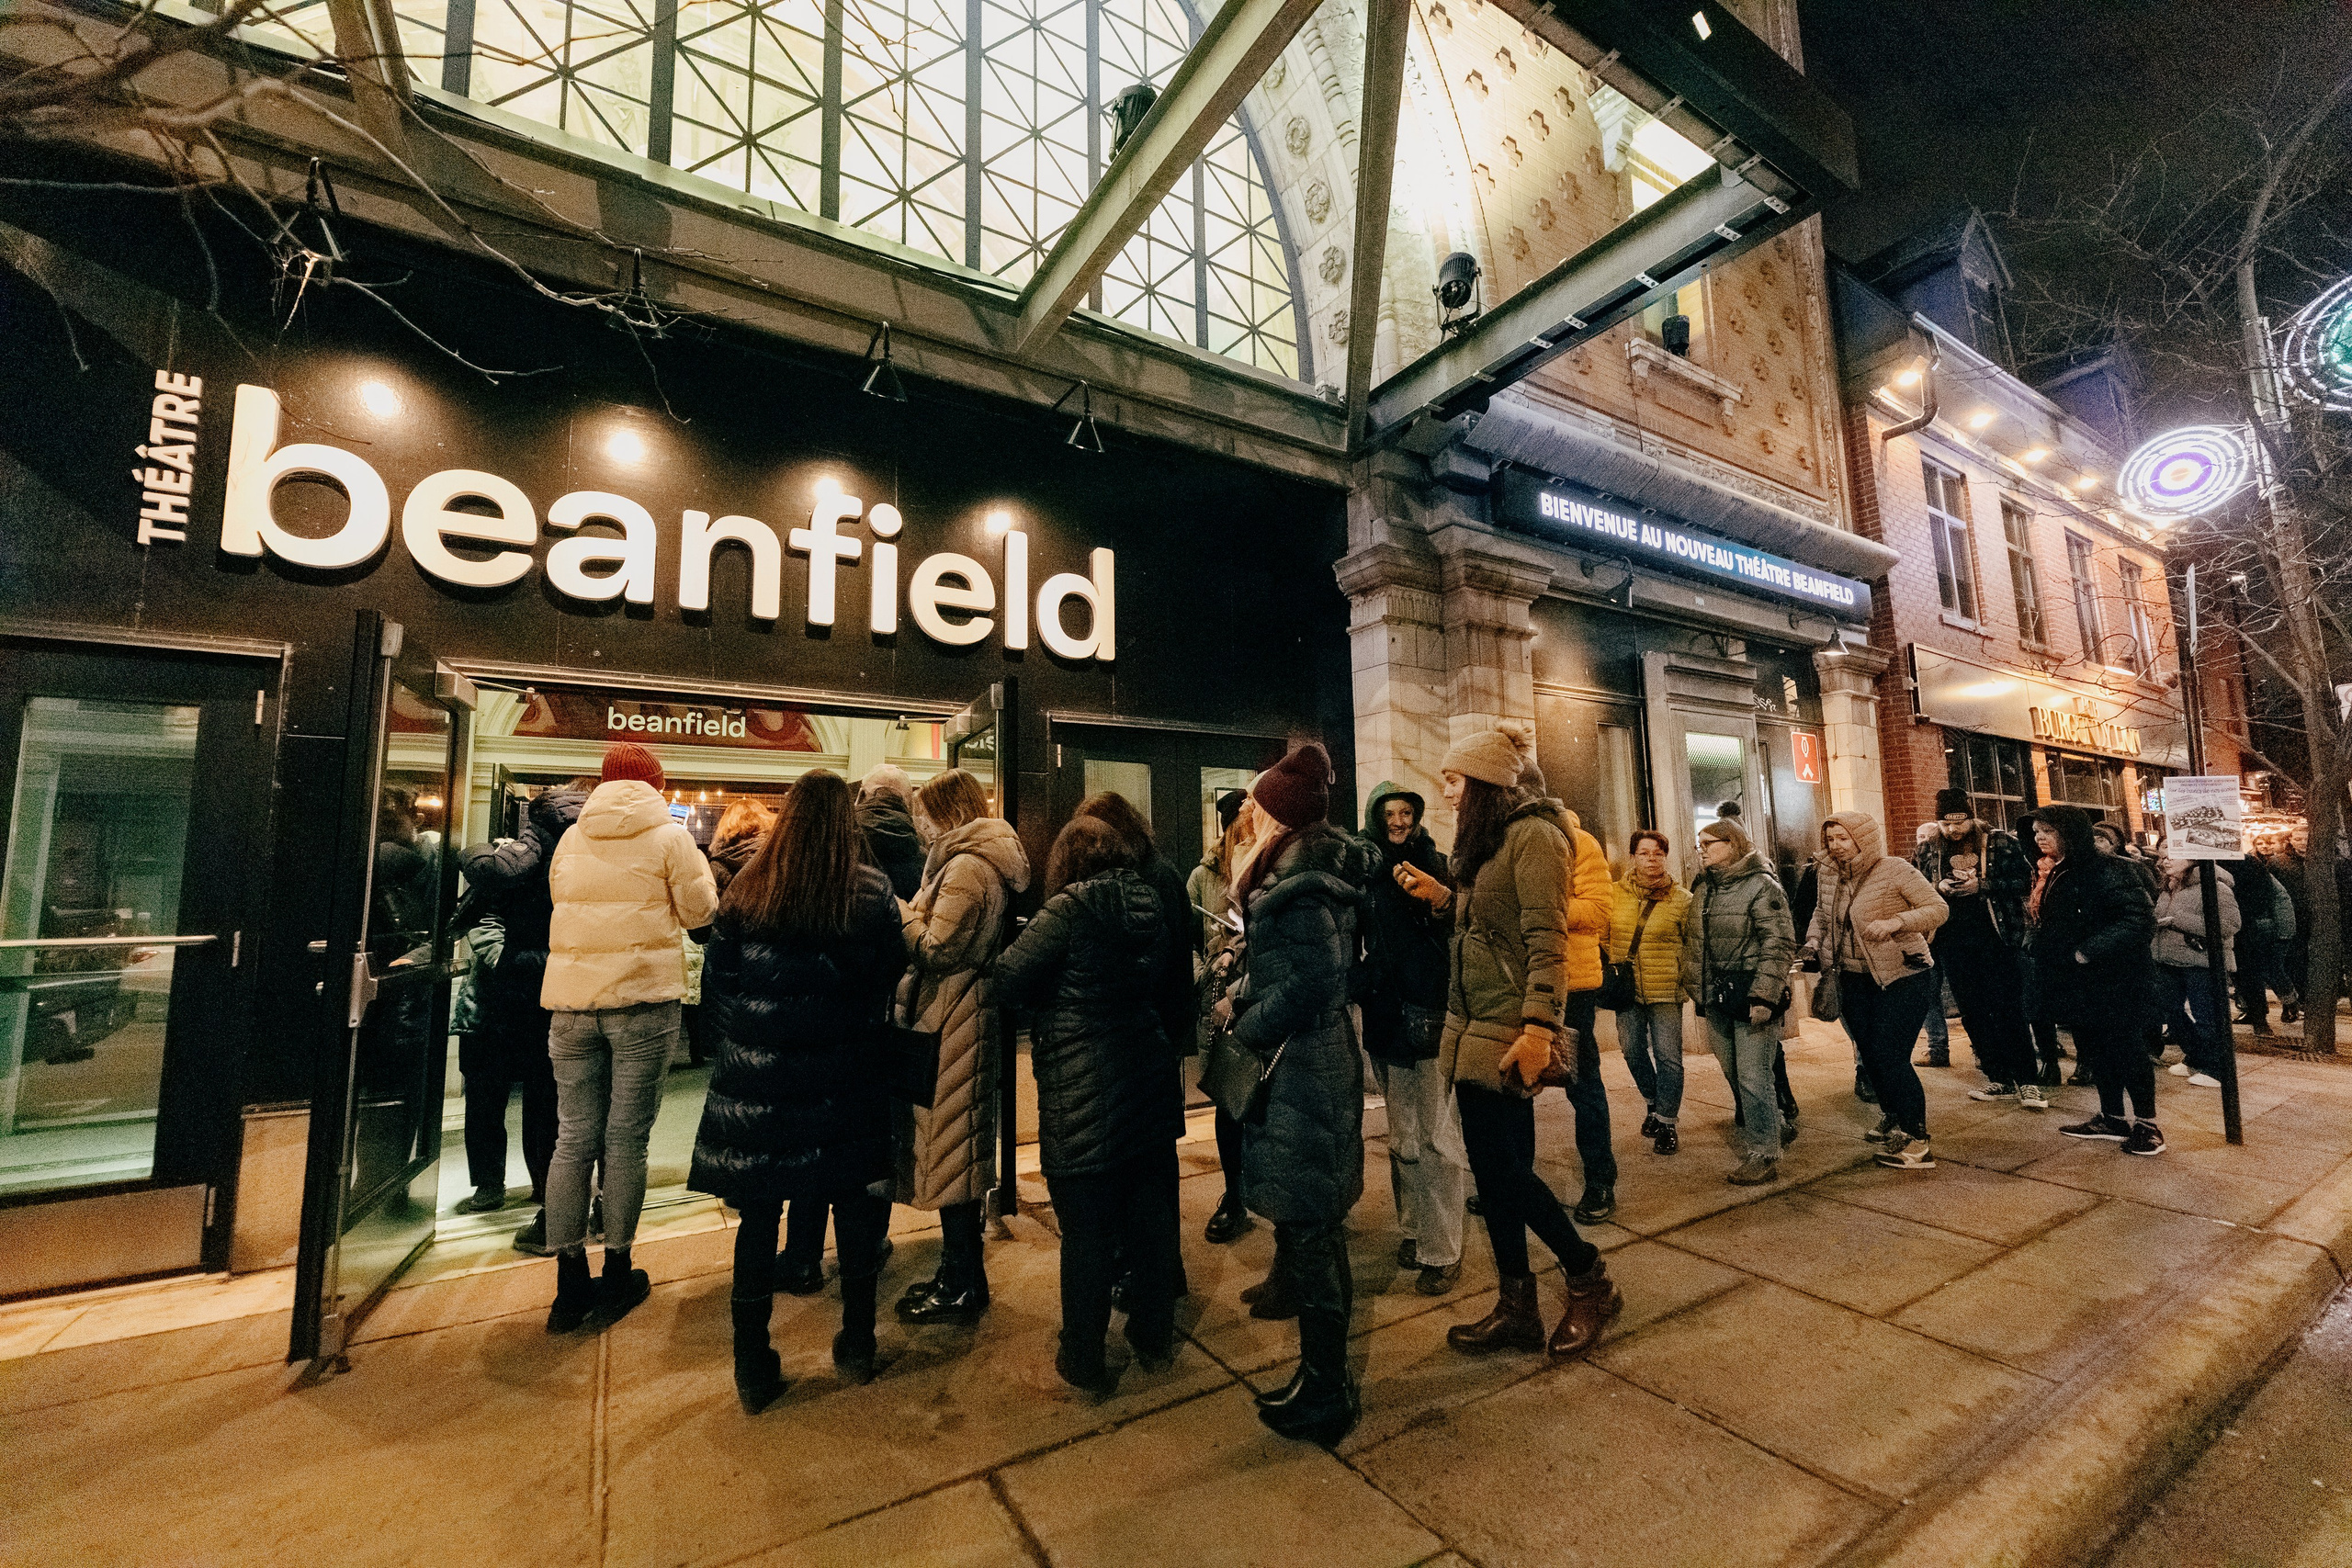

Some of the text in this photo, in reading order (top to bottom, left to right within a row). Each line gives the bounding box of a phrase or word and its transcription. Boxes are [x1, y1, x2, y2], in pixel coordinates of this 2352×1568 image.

[132, 368, 203, 547] THÉÂTRE
[221, 383, 1115, 662] beanfield
[1541, 492, 1854, 605] BIENVENUE AU NOUVEAU THÉÂTRE BEANFIELD
[607, 706, 747, 739] beanfield
